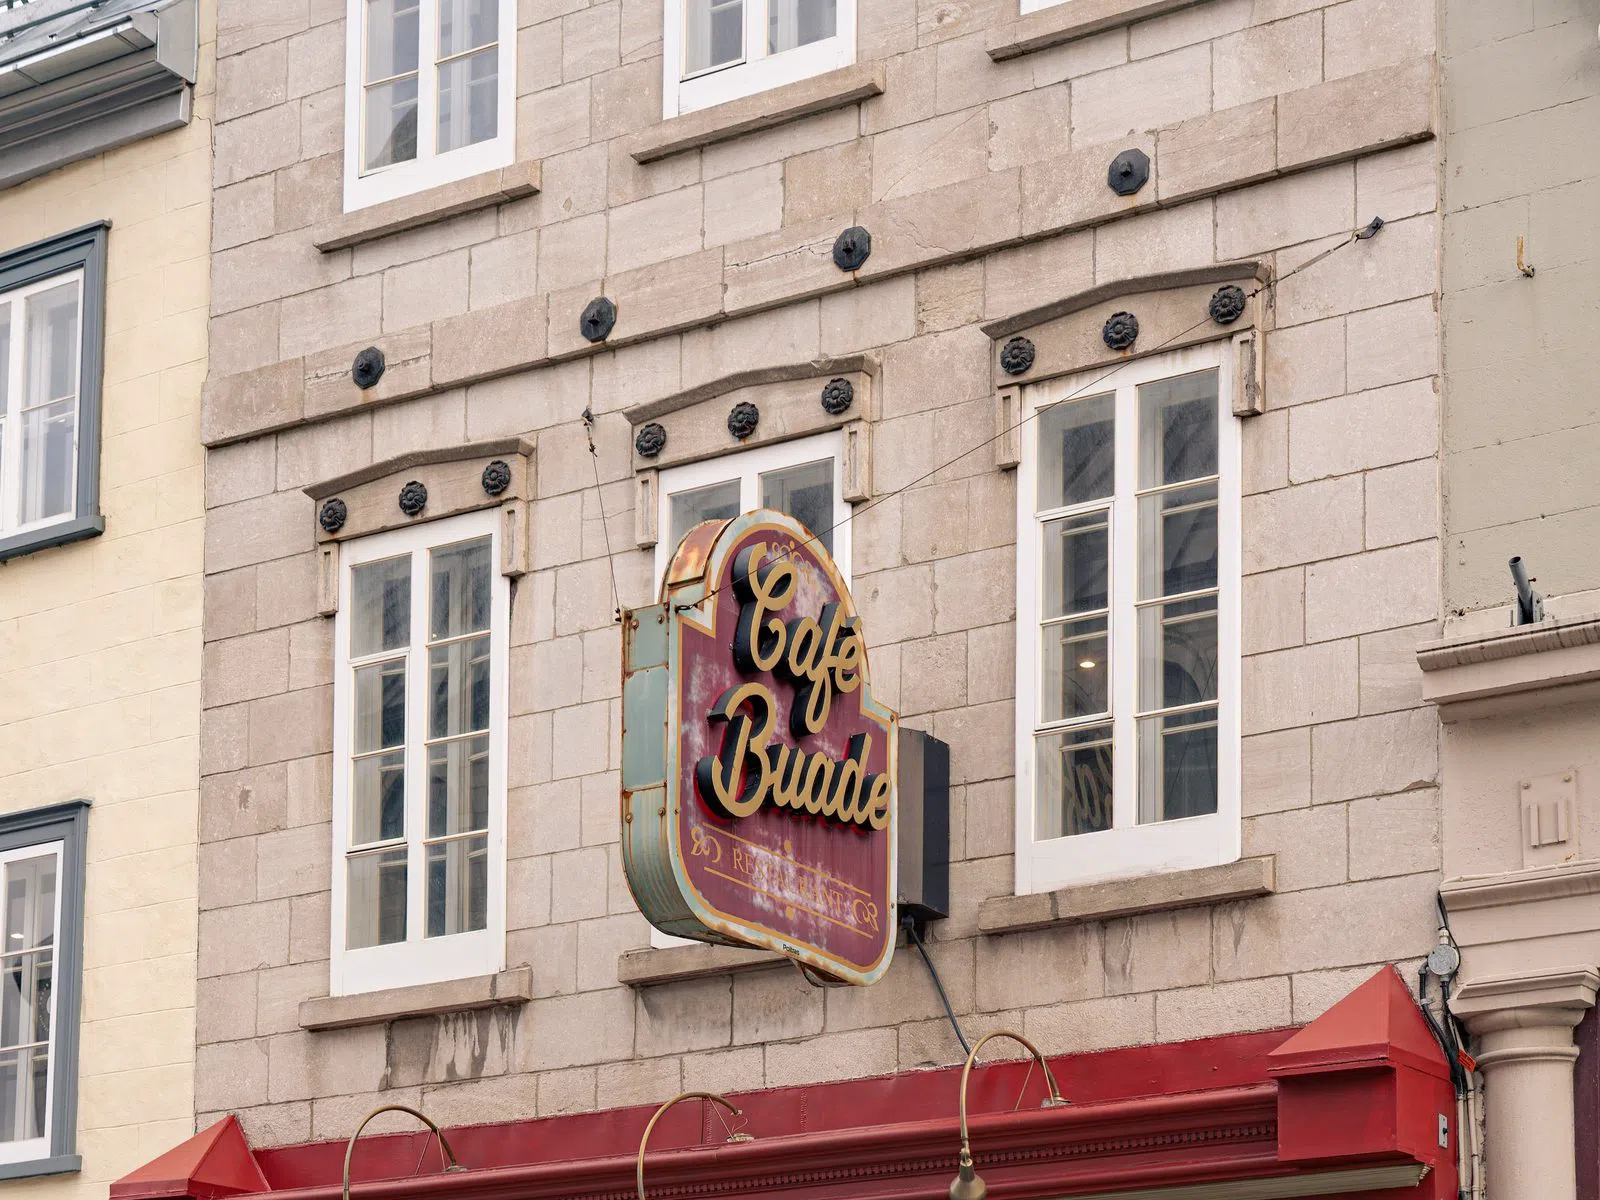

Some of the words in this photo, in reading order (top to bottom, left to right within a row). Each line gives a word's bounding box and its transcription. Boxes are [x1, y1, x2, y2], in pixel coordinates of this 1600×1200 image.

[744, 541, 862, 735] Café
[706, 682, 893, 831] Buade
[732, 847, 845, 918] RESTARANT
